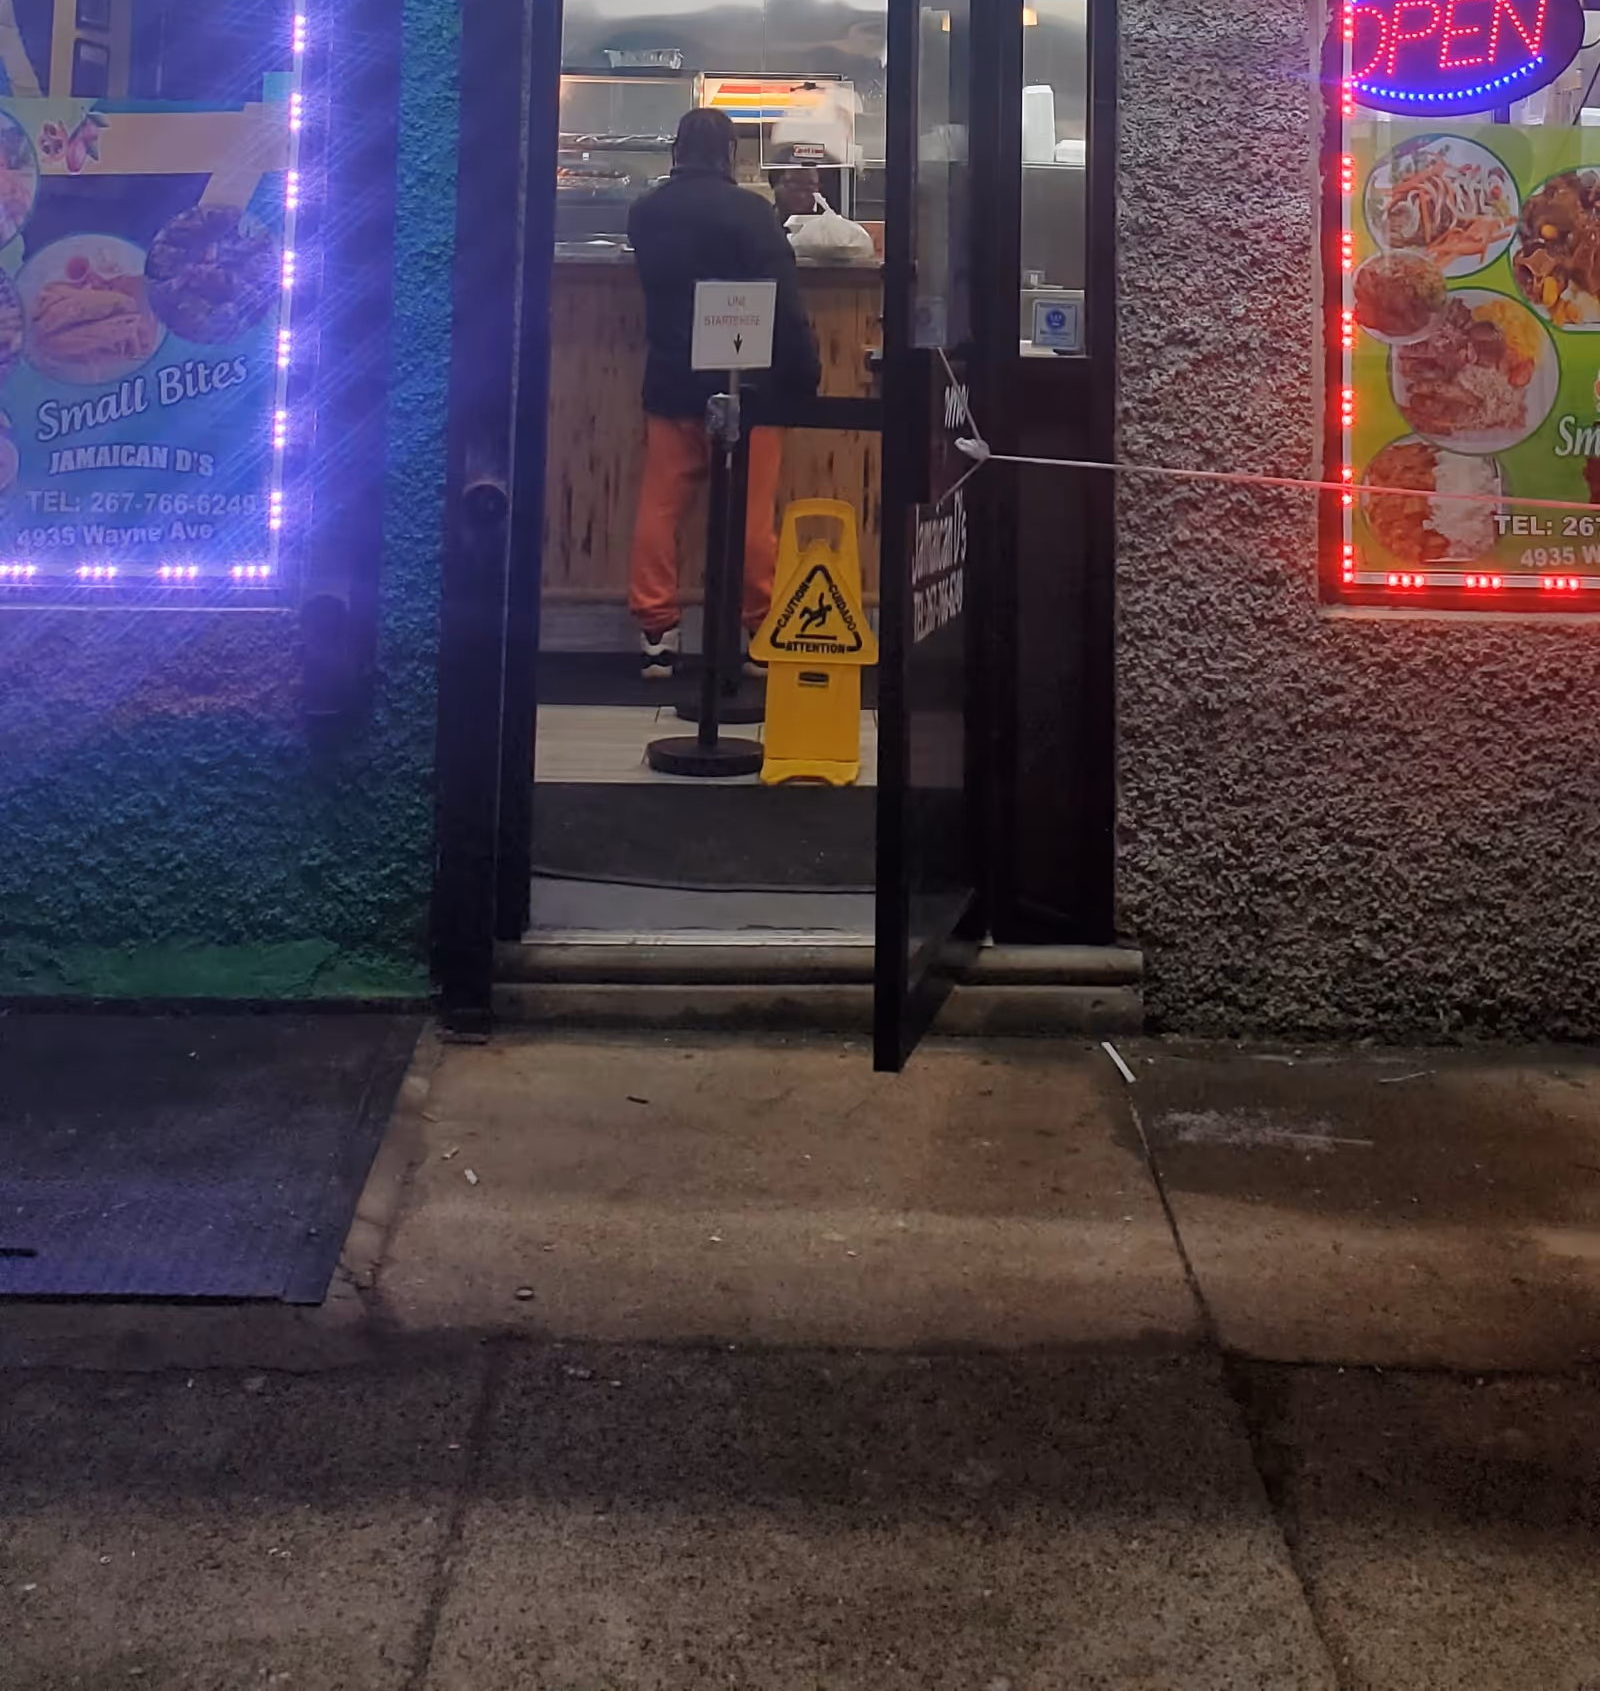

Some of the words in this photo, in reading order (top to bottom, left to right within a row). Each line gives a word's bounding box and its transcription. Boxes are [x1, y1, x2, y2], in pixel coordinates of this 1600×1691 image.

[37, 376, 149, 441] Small
[157, 355, 248, 407] Bites
[49, 444, 169, 476] JAMAICAN
[26, 490, 81, 513] TEL:
[90, 491, 257, 515] 267-766-6249
[17, 527, 76, 548] 4935
[83, 523, 162, 546] Wayne
[1493, 514, 1553, 537] TEL:
[1520, 547, 1576, 569] 4935
[777, 581, 810, 629] CAUTION
[828, 583, 857, 632] CUIDADO
[784, 640, 846, 655] ATTENTION
